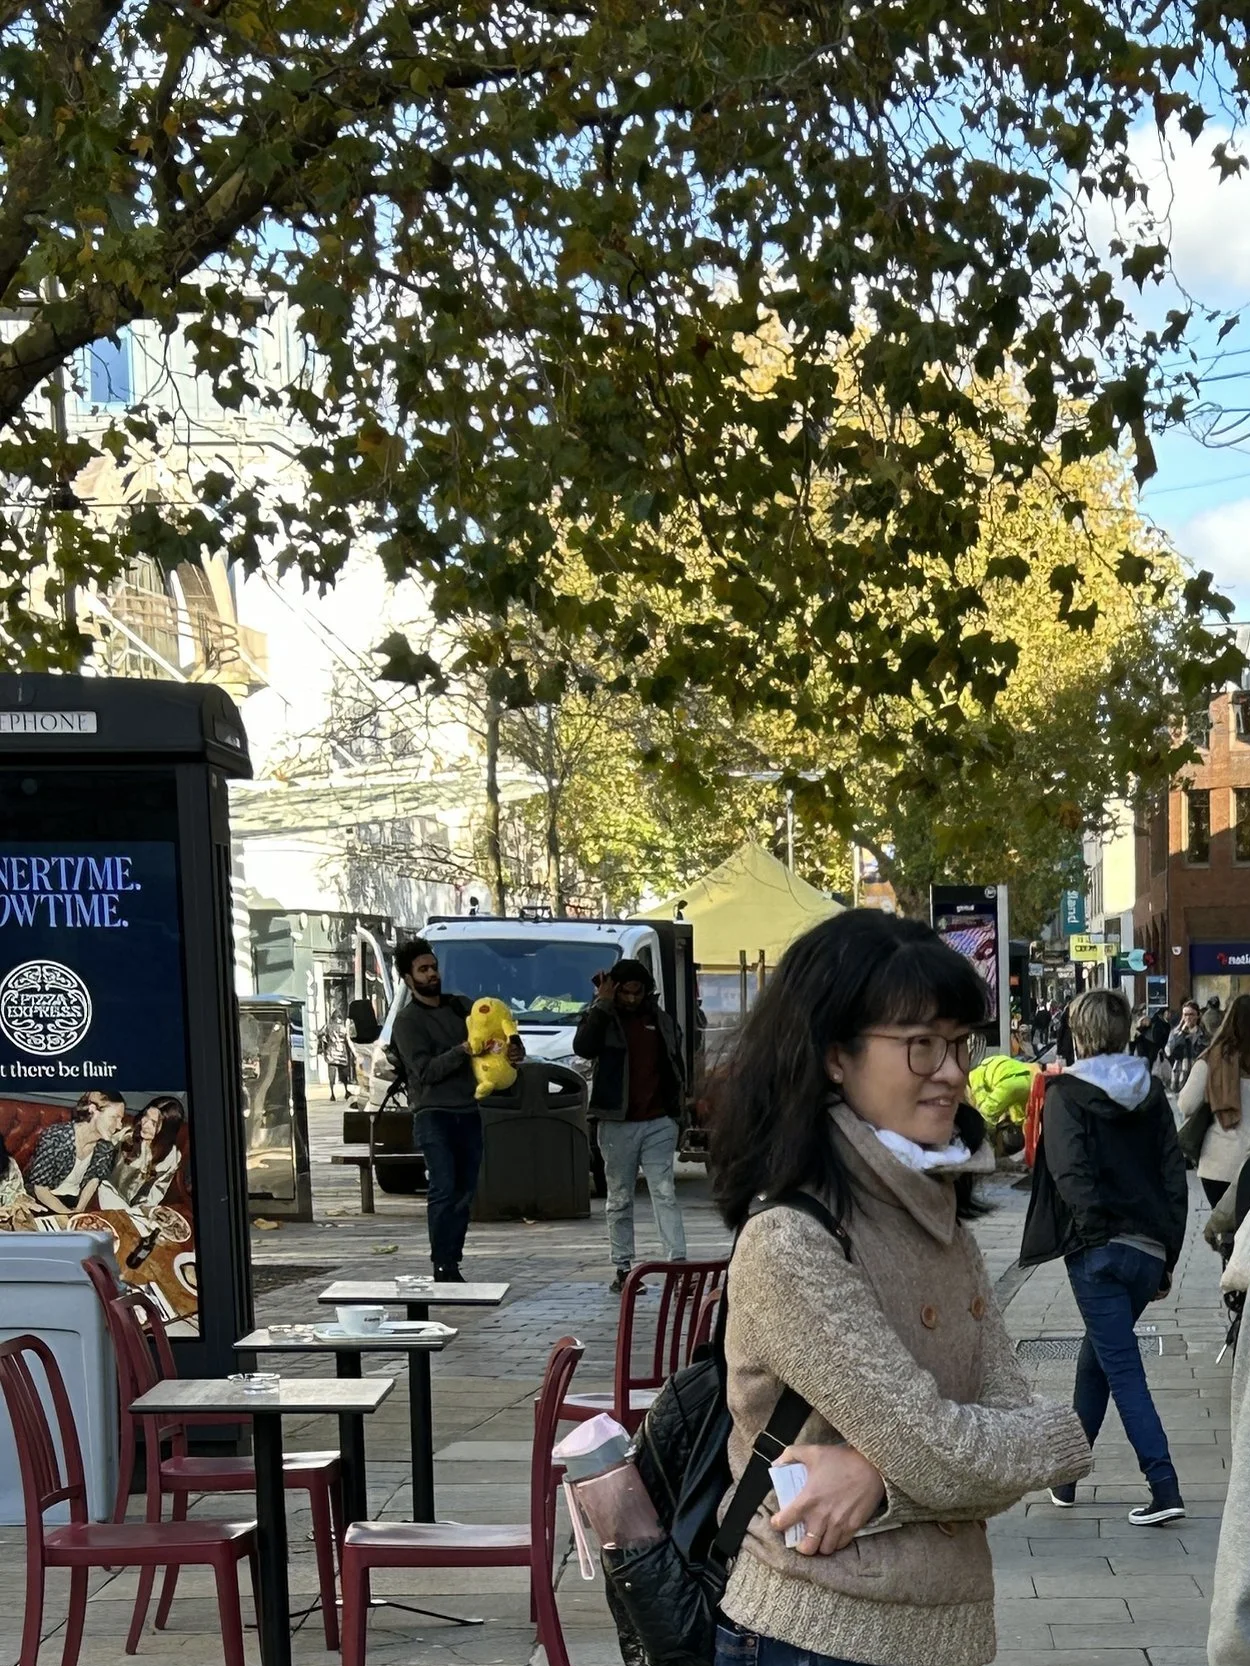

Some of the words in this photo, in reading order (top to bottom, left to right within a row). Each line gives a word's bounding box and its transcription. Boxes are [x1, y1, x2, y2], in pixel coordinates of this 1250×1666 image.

[20, 993, 69, 1006] PIZZA
[6, 1005, 83, 1018] EXPRESS
[10, 1061, 56, 1078] there
[58, 1061, 80, 1078] be
[83, 1060, 118, 1078] flair
